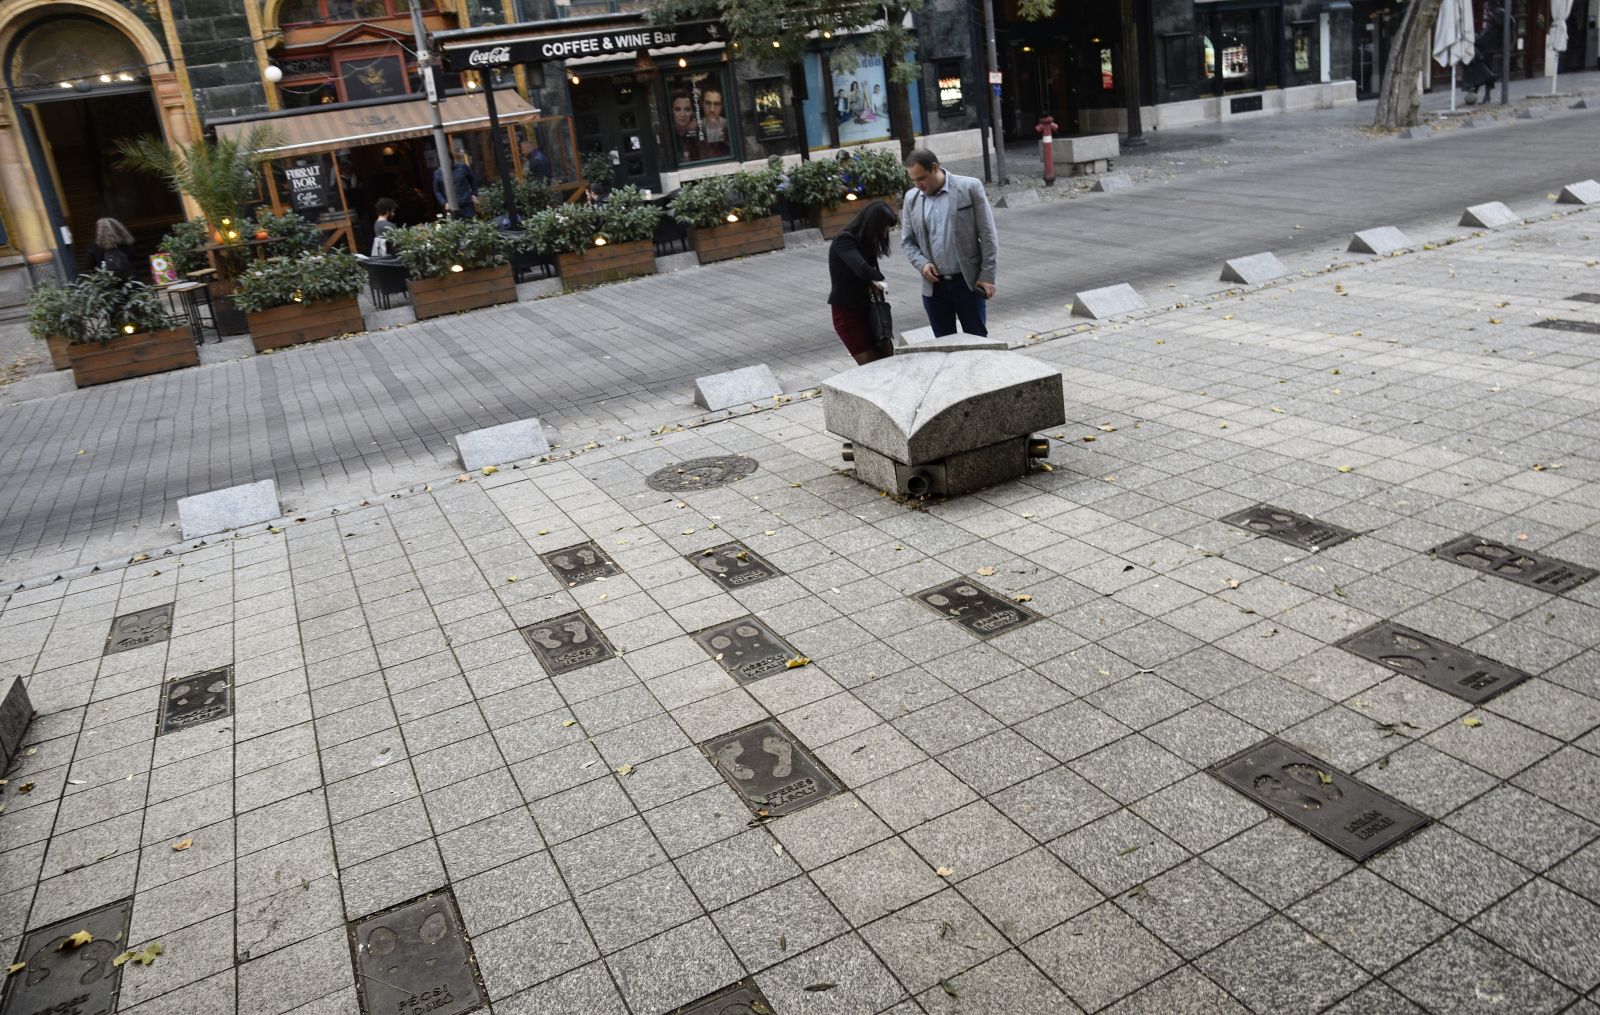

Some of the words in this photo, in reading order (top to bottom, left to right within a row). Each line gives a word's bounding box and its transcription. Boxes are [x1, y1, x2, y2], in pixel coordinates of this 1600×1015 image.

[542, 38, 599, 57] COFFEE
[602, 37, 612, 50] &
[615, 33, 651, 49] WINE
[654, 31, 677, 44] Bar
[763, 777, 814, 802] EPERJES
[769, 785, 817, 809] KÁROLY
[397, 984, 449, 1012] PÉCSI
